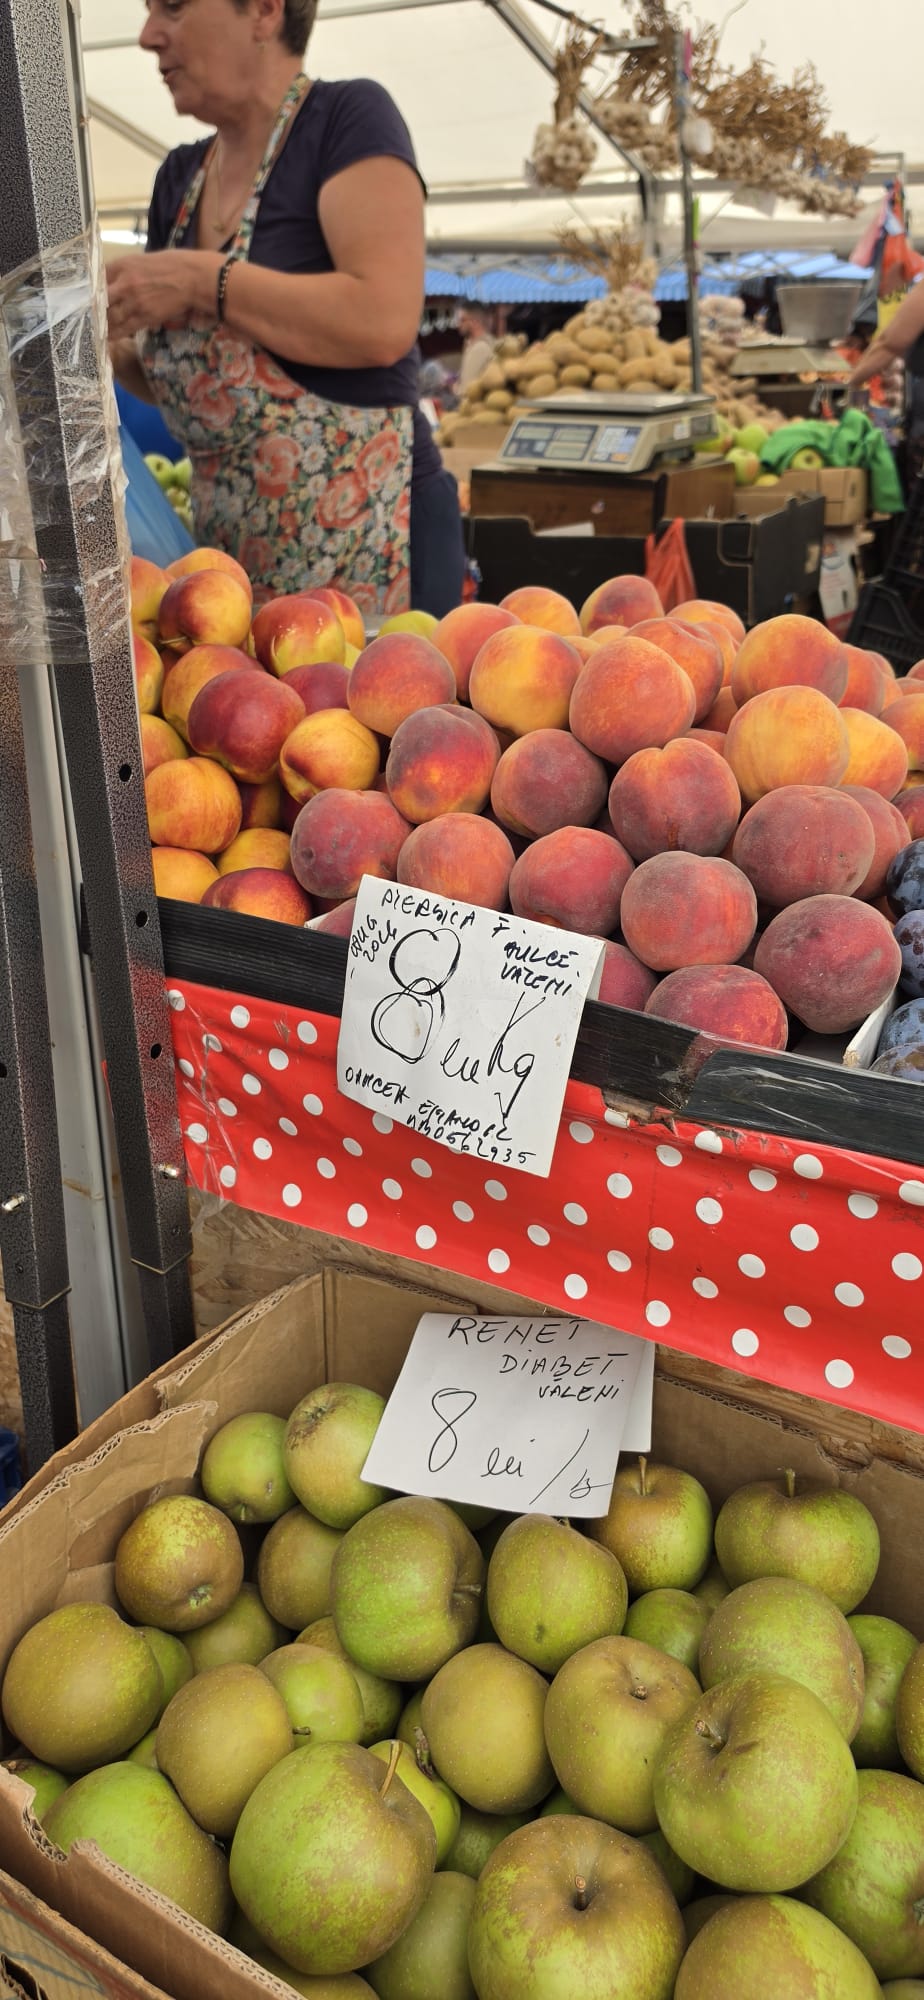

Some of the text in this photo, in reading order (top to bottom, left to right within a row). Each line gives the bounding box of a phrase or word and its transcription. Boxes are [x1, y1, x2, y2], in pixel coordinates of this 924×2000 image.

[370, 928, 462, 1065] 8
[447, 1316, 591, 1345] RENET
[428, 1387, 477, 1473] 8
